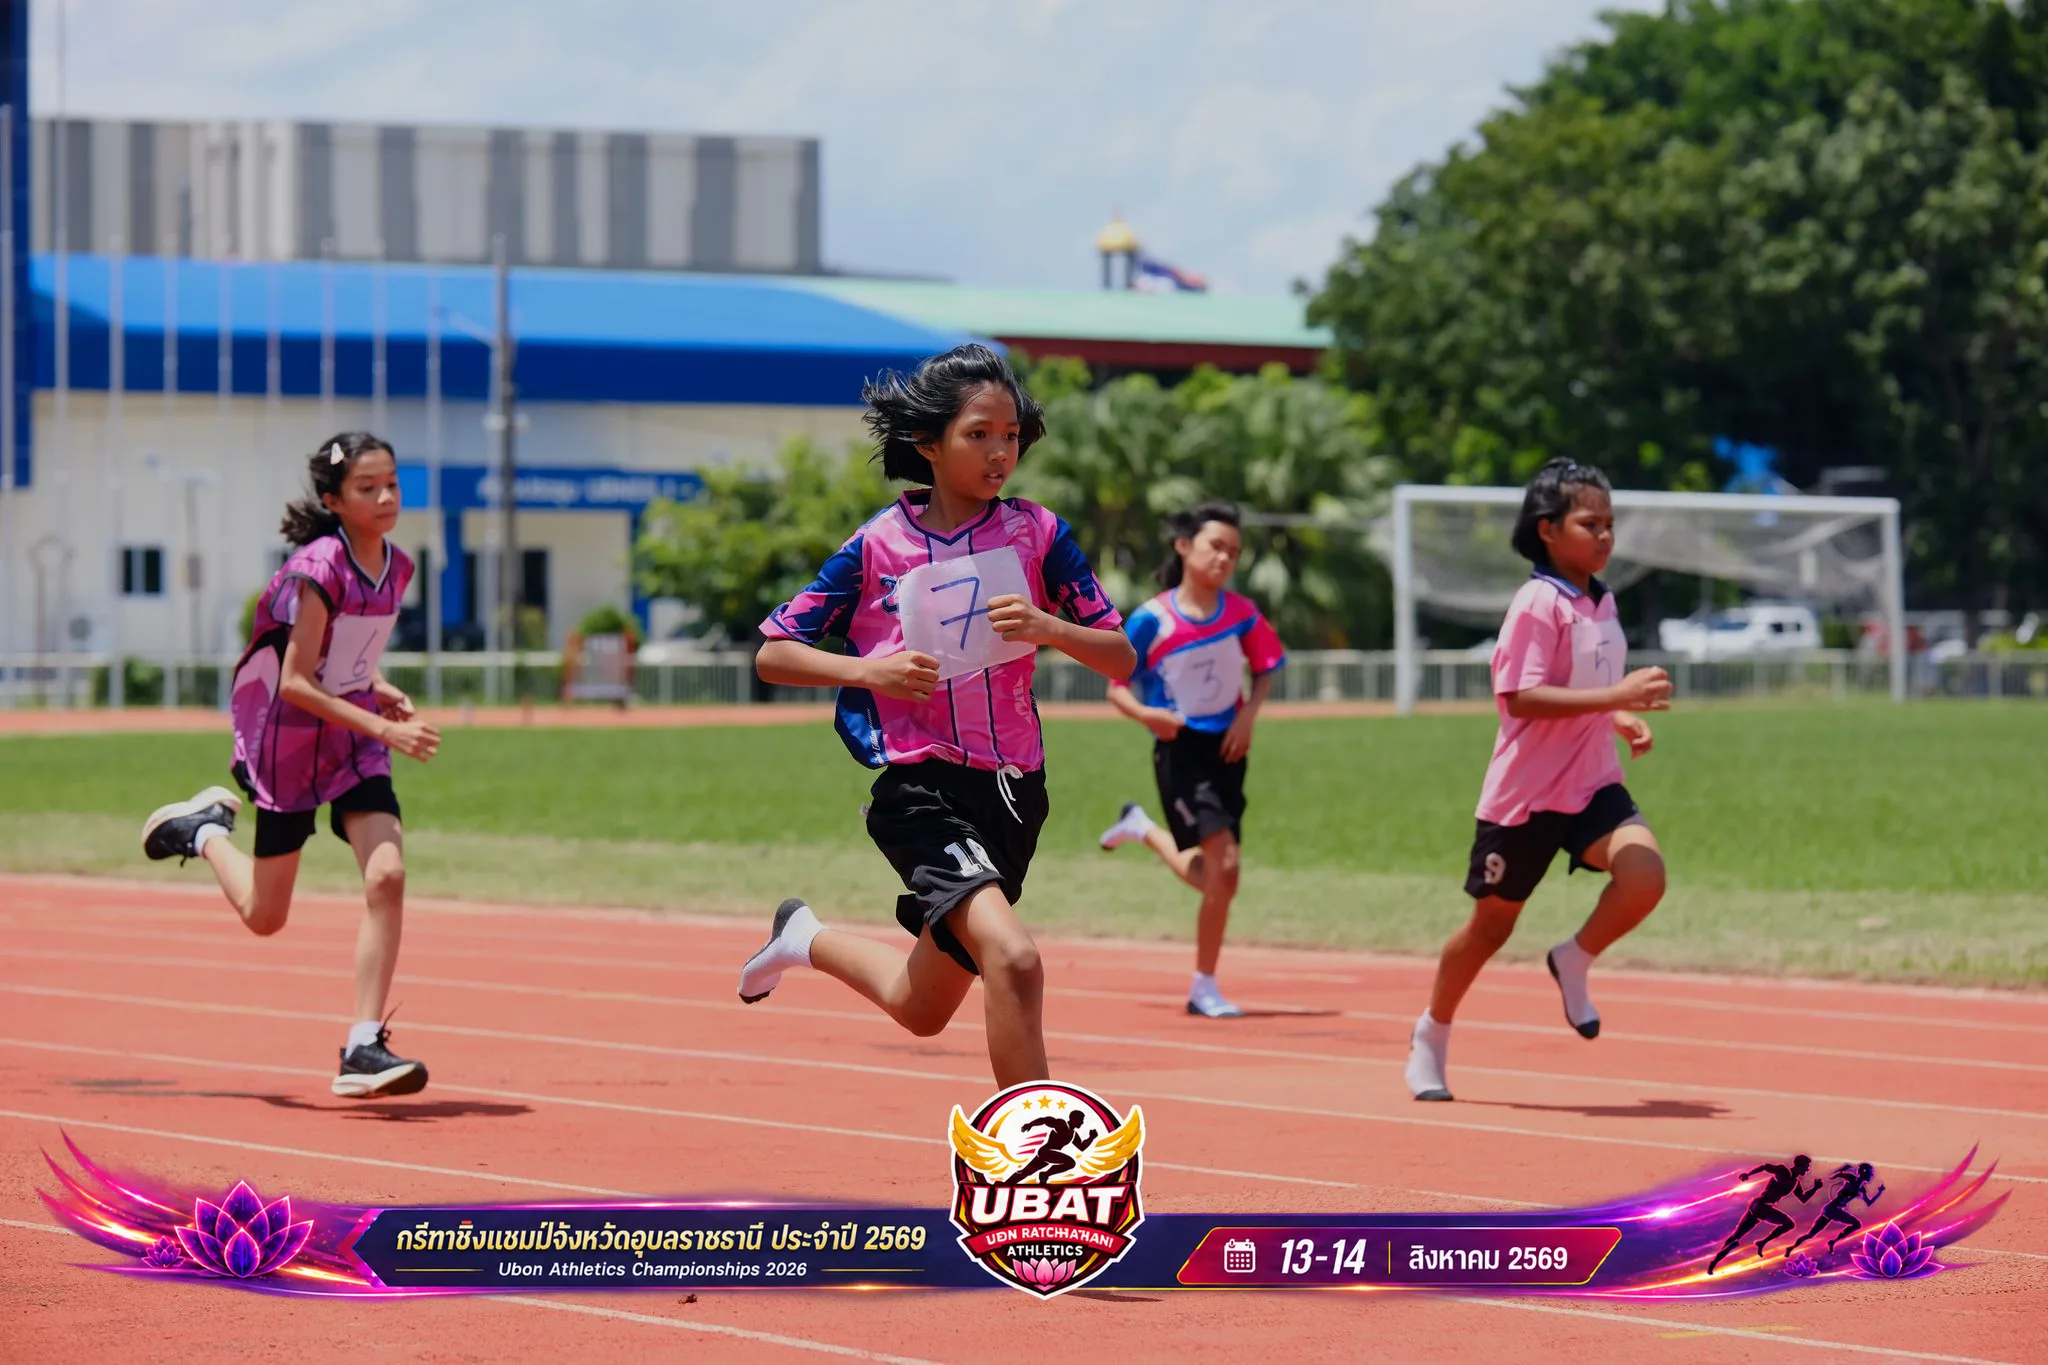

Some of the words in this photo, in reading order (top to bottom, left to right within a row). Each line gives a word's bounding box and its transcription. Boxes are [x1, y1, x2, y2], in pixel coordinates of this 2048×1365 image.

[930, 576, 991, 651] 7
[352, 629, 378, 678] 6
[1594, 640, 1612, 687] 5
[1192, 658, 1224, 702] 3
[1484, 852, 1506, 885] 9
